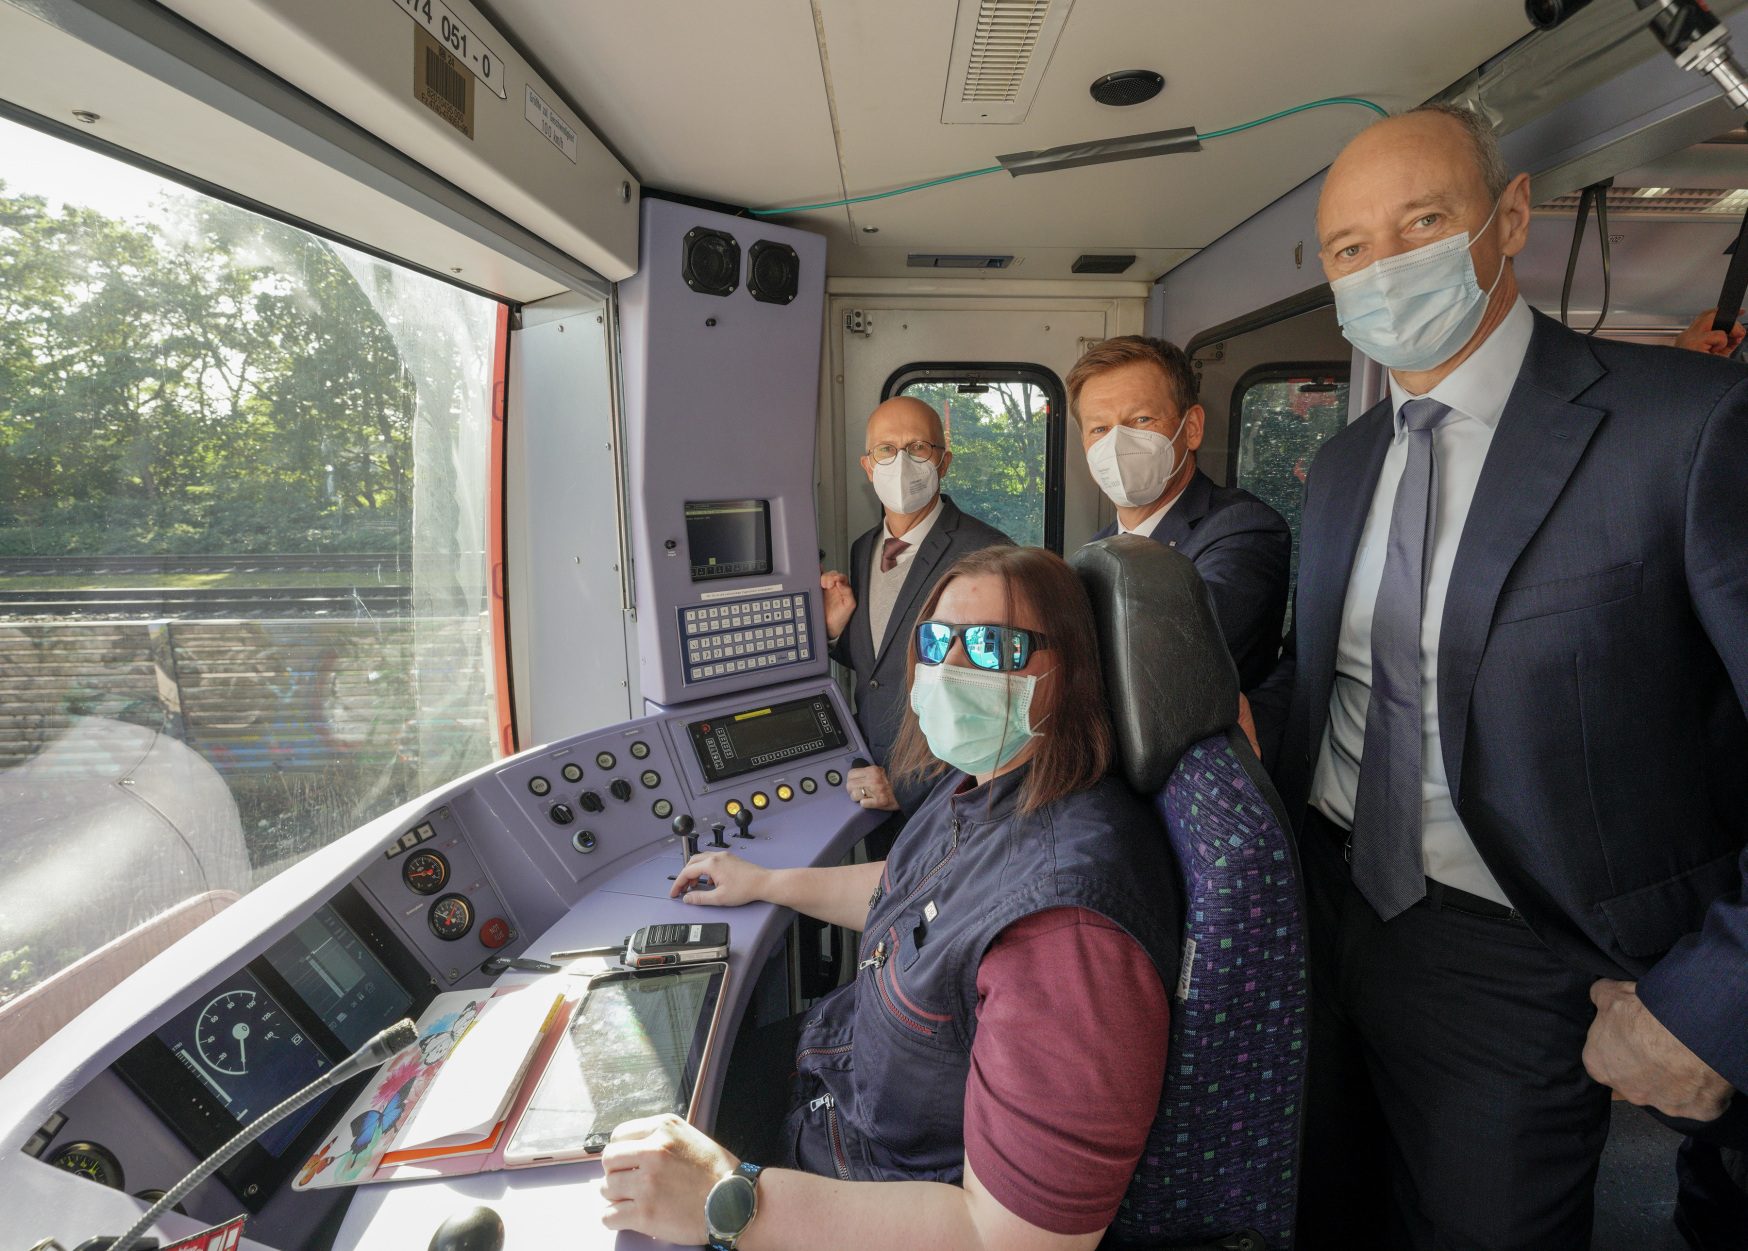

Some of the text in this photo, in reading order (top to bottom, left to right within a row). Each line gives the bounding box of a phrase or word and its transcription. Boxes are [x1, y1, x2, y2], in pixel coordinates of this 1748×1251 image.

[442, 15, 467, 58] 051
[482, 53, 491, 78] 0
[246, 1000, 256, 1009] 100
[261, 1012, 272, 1021] 120
[264, 1031, 274, 1040] 140
